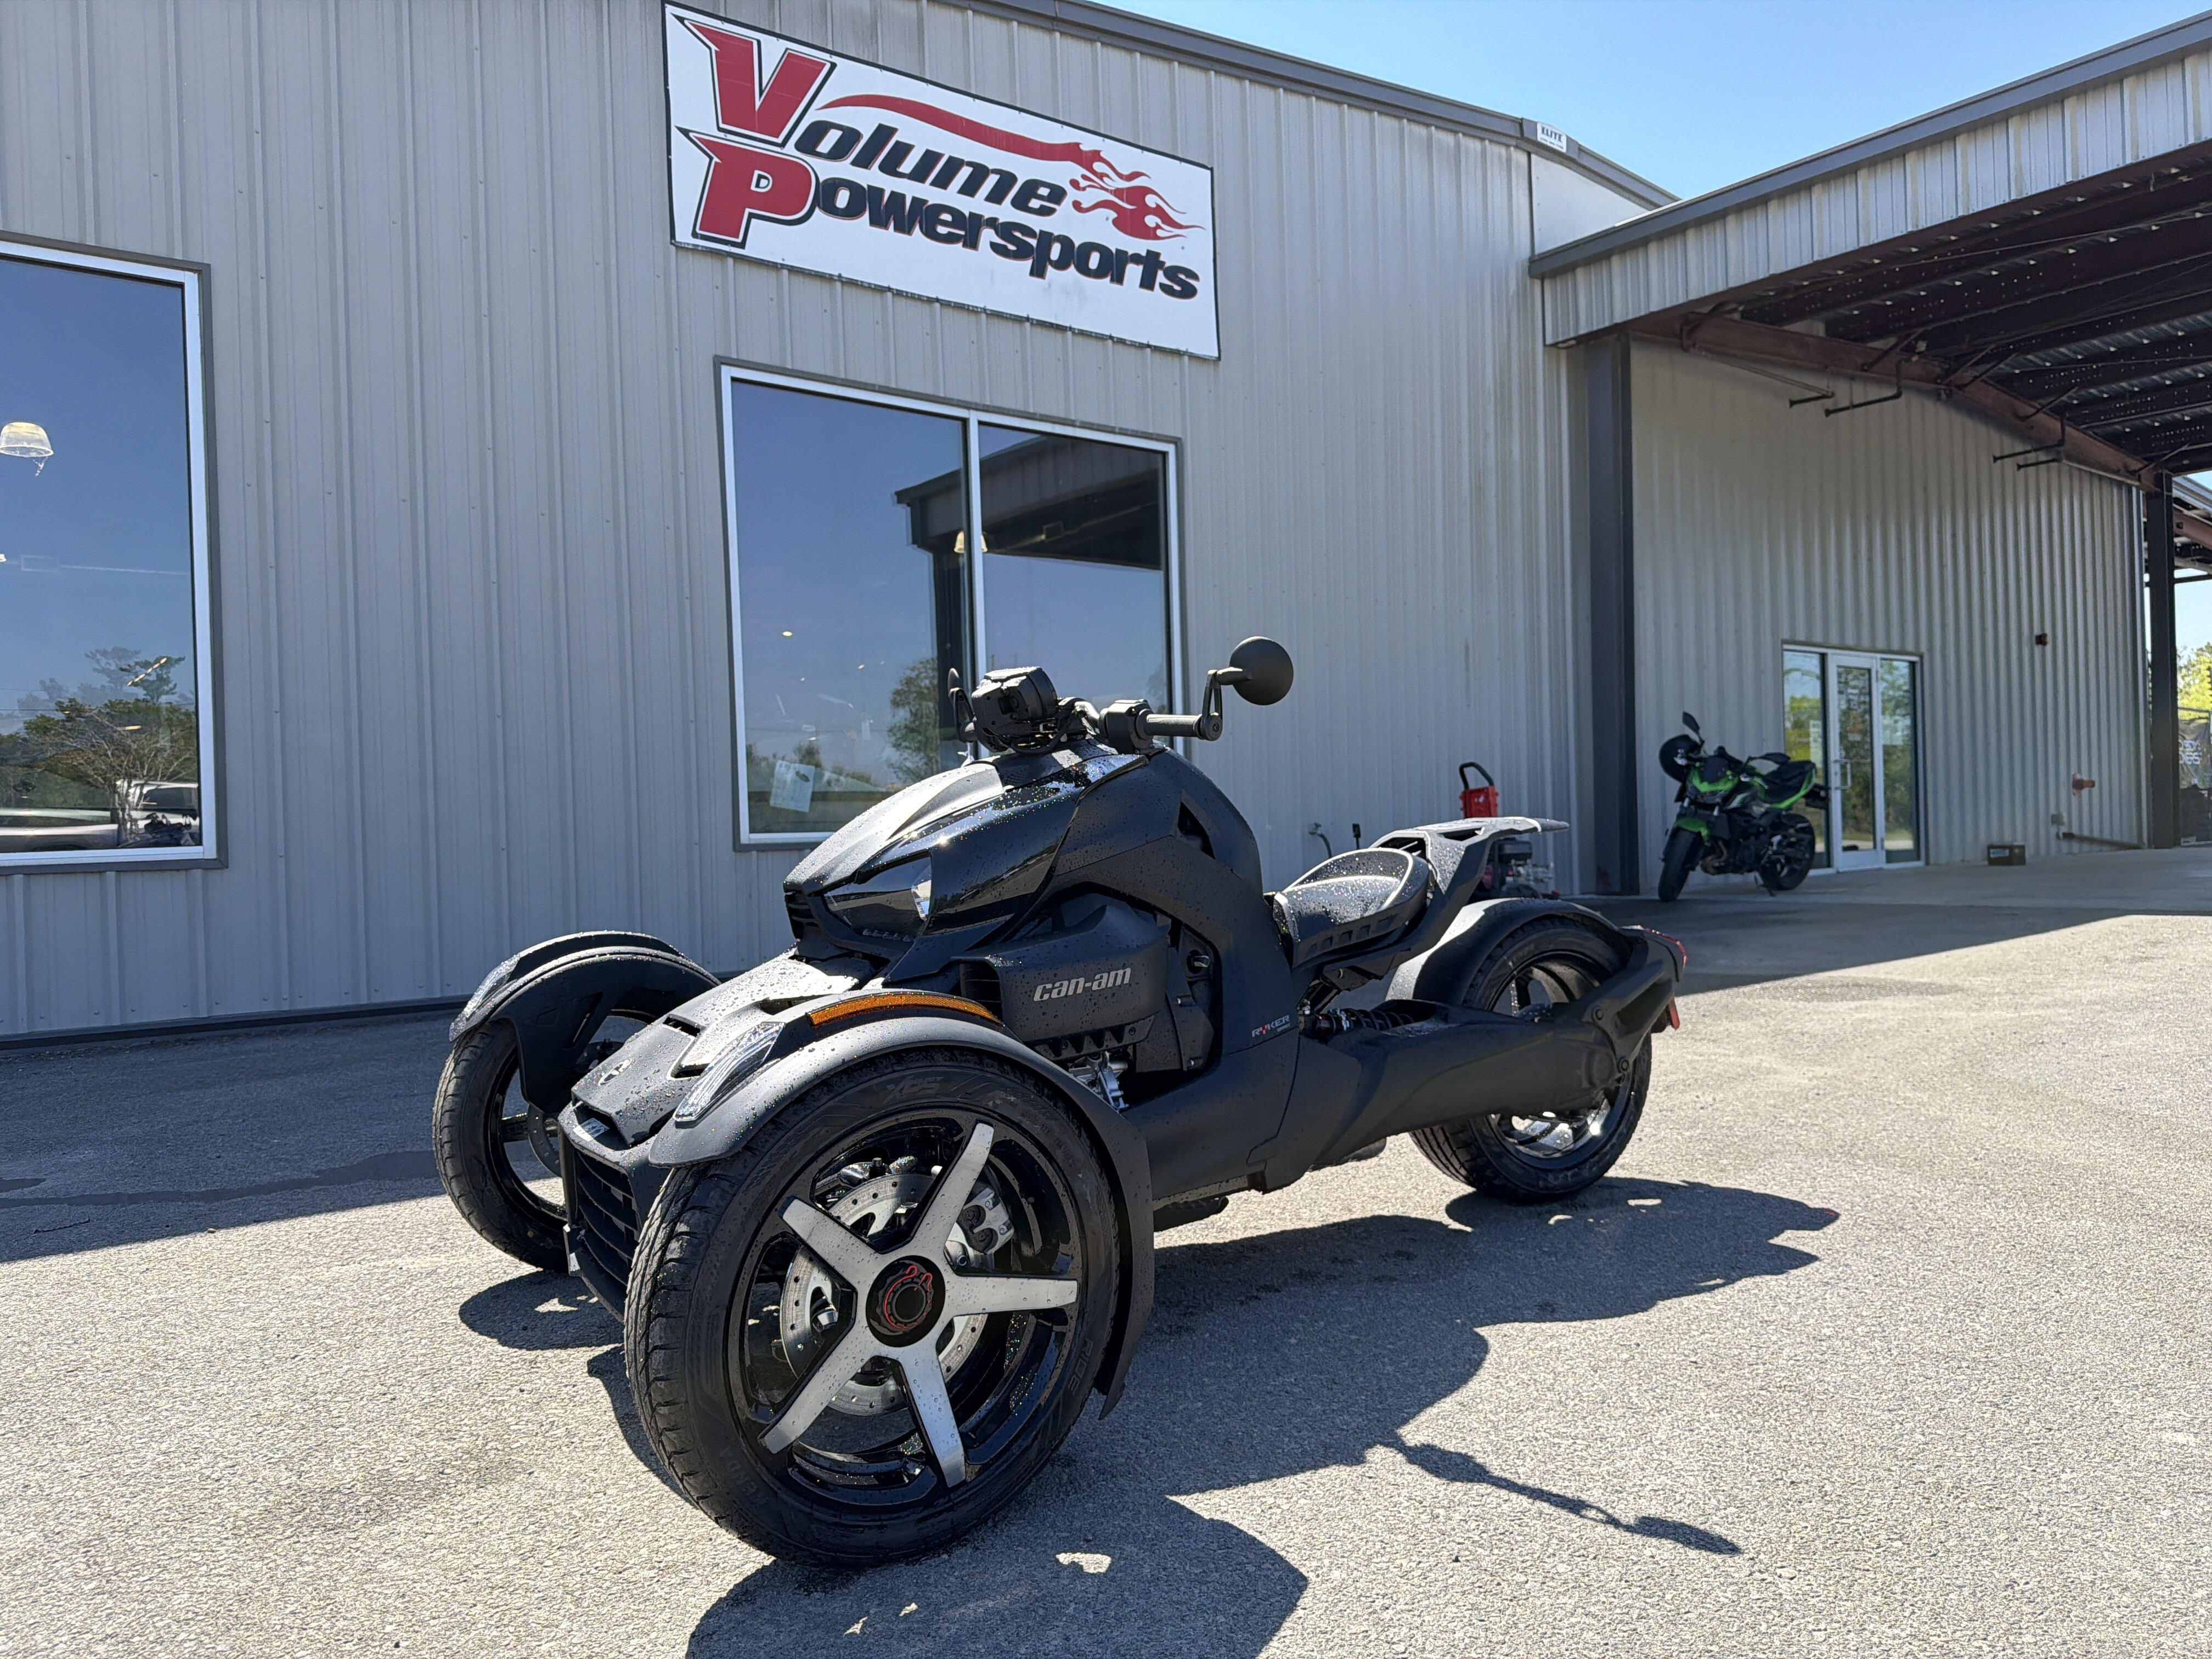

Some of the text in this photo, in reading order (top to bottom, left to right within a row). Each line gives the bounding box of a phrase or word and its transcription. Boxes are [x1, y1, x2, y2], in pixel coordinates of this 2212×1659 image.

[670, 13, 1068, 217] Volume
[1541, 126, 1564, 143] ELITE
[674, 126, 1200, 299] Powersports
[1033, 967, 1131, 1002] can-am
[1251, 1014, 1290, 1037] RYKER
